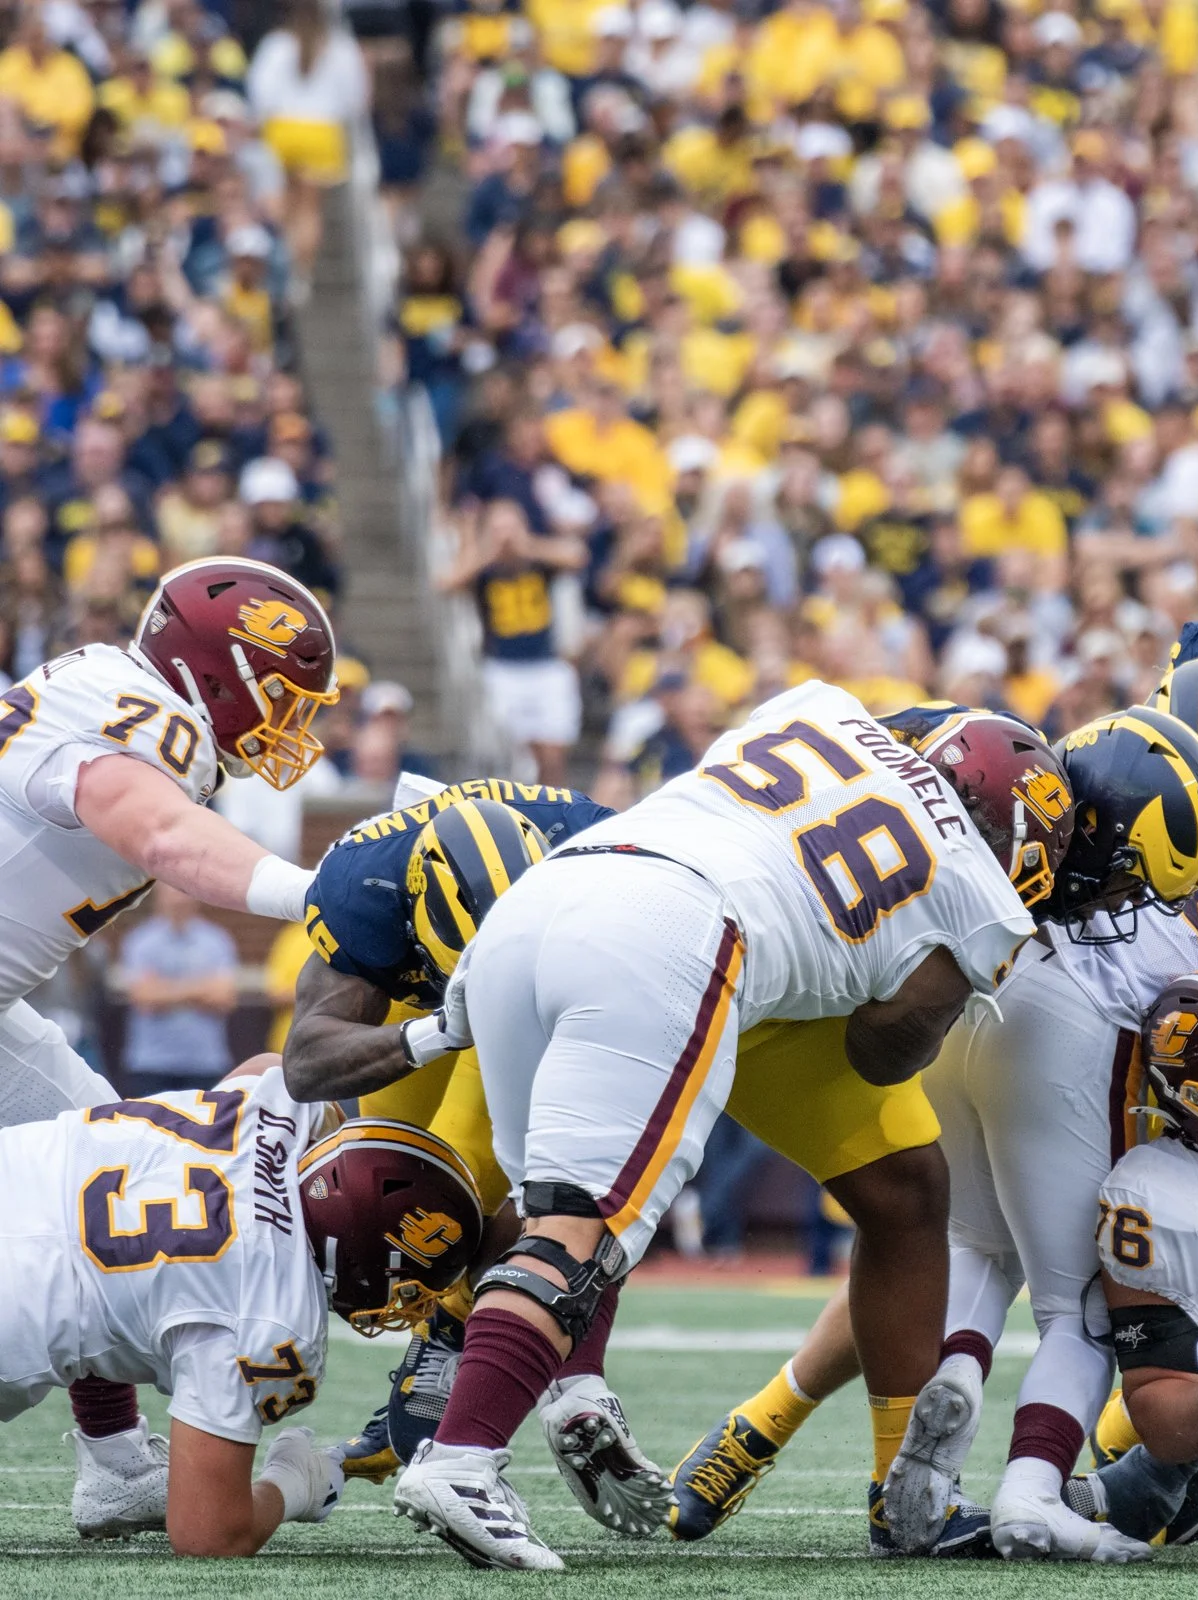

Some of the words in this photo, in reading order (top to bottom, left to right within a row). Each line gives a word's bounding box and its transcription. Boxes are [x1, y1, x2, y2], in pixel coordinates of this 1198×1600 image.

[100, 693, 203, 778] 70
[838, 719, 966, 839] POUMELE
[352, 777, 573, 844] HAUSMANN
[699, 718, 938, 945] 58
[79, 1088, 248, 1273] 73
[235, 1339, 318, 1424] 73
